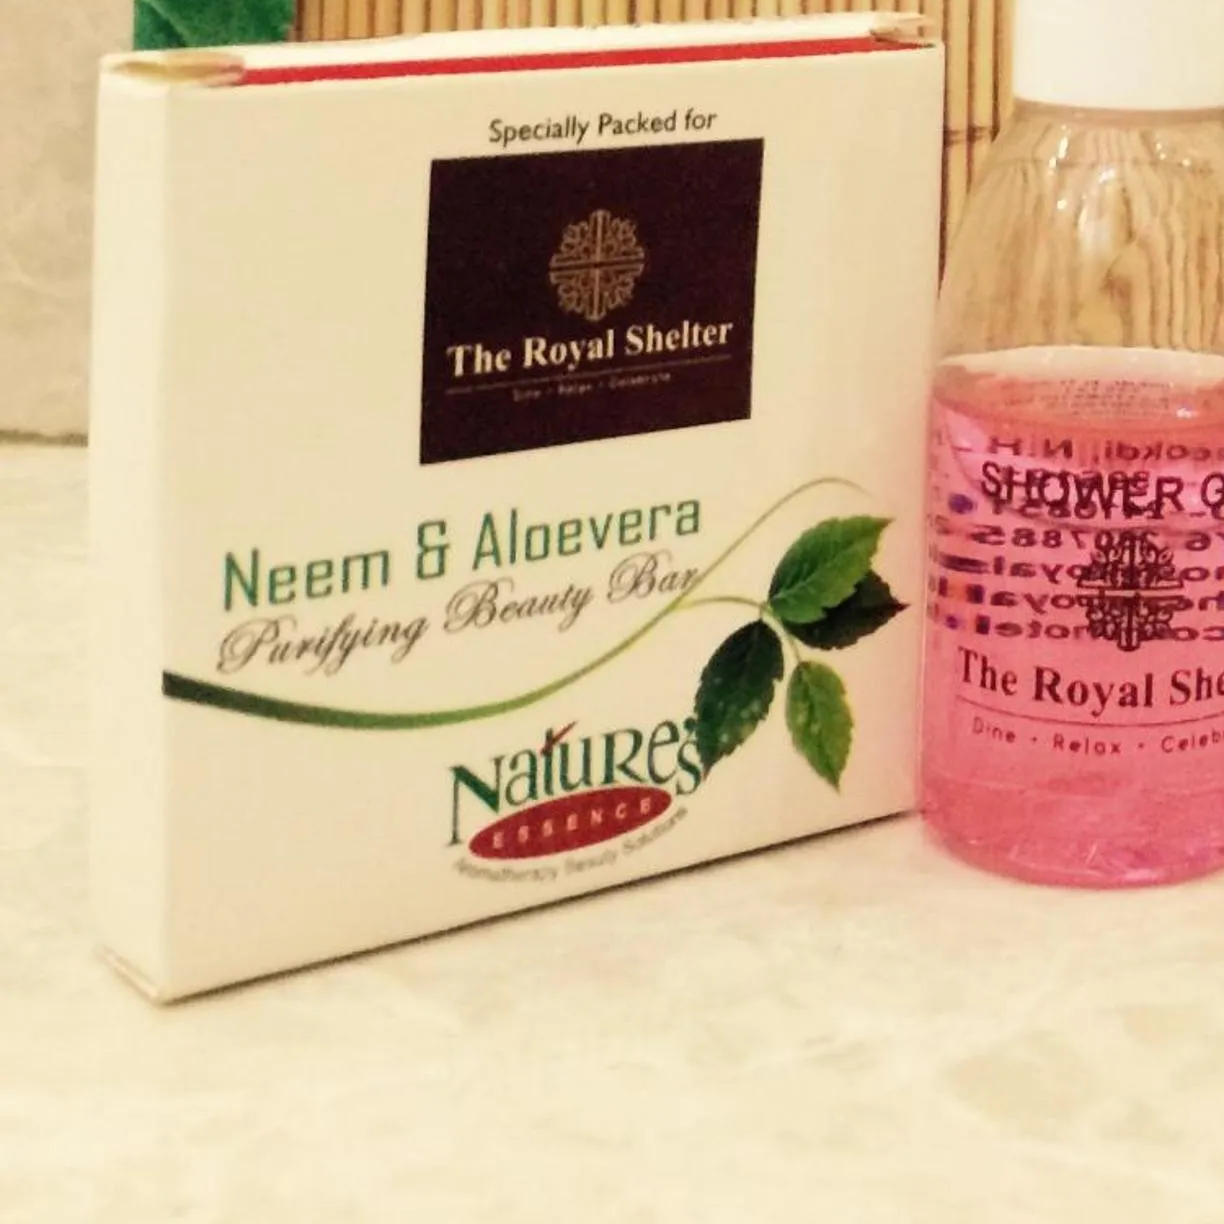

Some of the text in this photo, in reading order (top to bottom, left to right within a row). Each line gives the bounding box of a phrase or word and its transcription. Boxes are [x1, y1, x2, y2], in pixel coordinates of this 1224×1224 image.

[489, 106, 717, 148] Specially Packed for
[446, 320, 733, 377] The Royal Shelter
[980, 460, 1185, 515] SHOWER
[223, 498, 701, 612] Neem & Aloevera
[216, 549, 698, 676] Purifying Beauty Bar
[958, 645, 1018, 697] The
[1033, 664, 1154, 718] Royal
[972, 716, 1017, 744] Dine
[1052, 733, 1122, 756] Relax
[492, 797, 651, 849] ESSENCE
